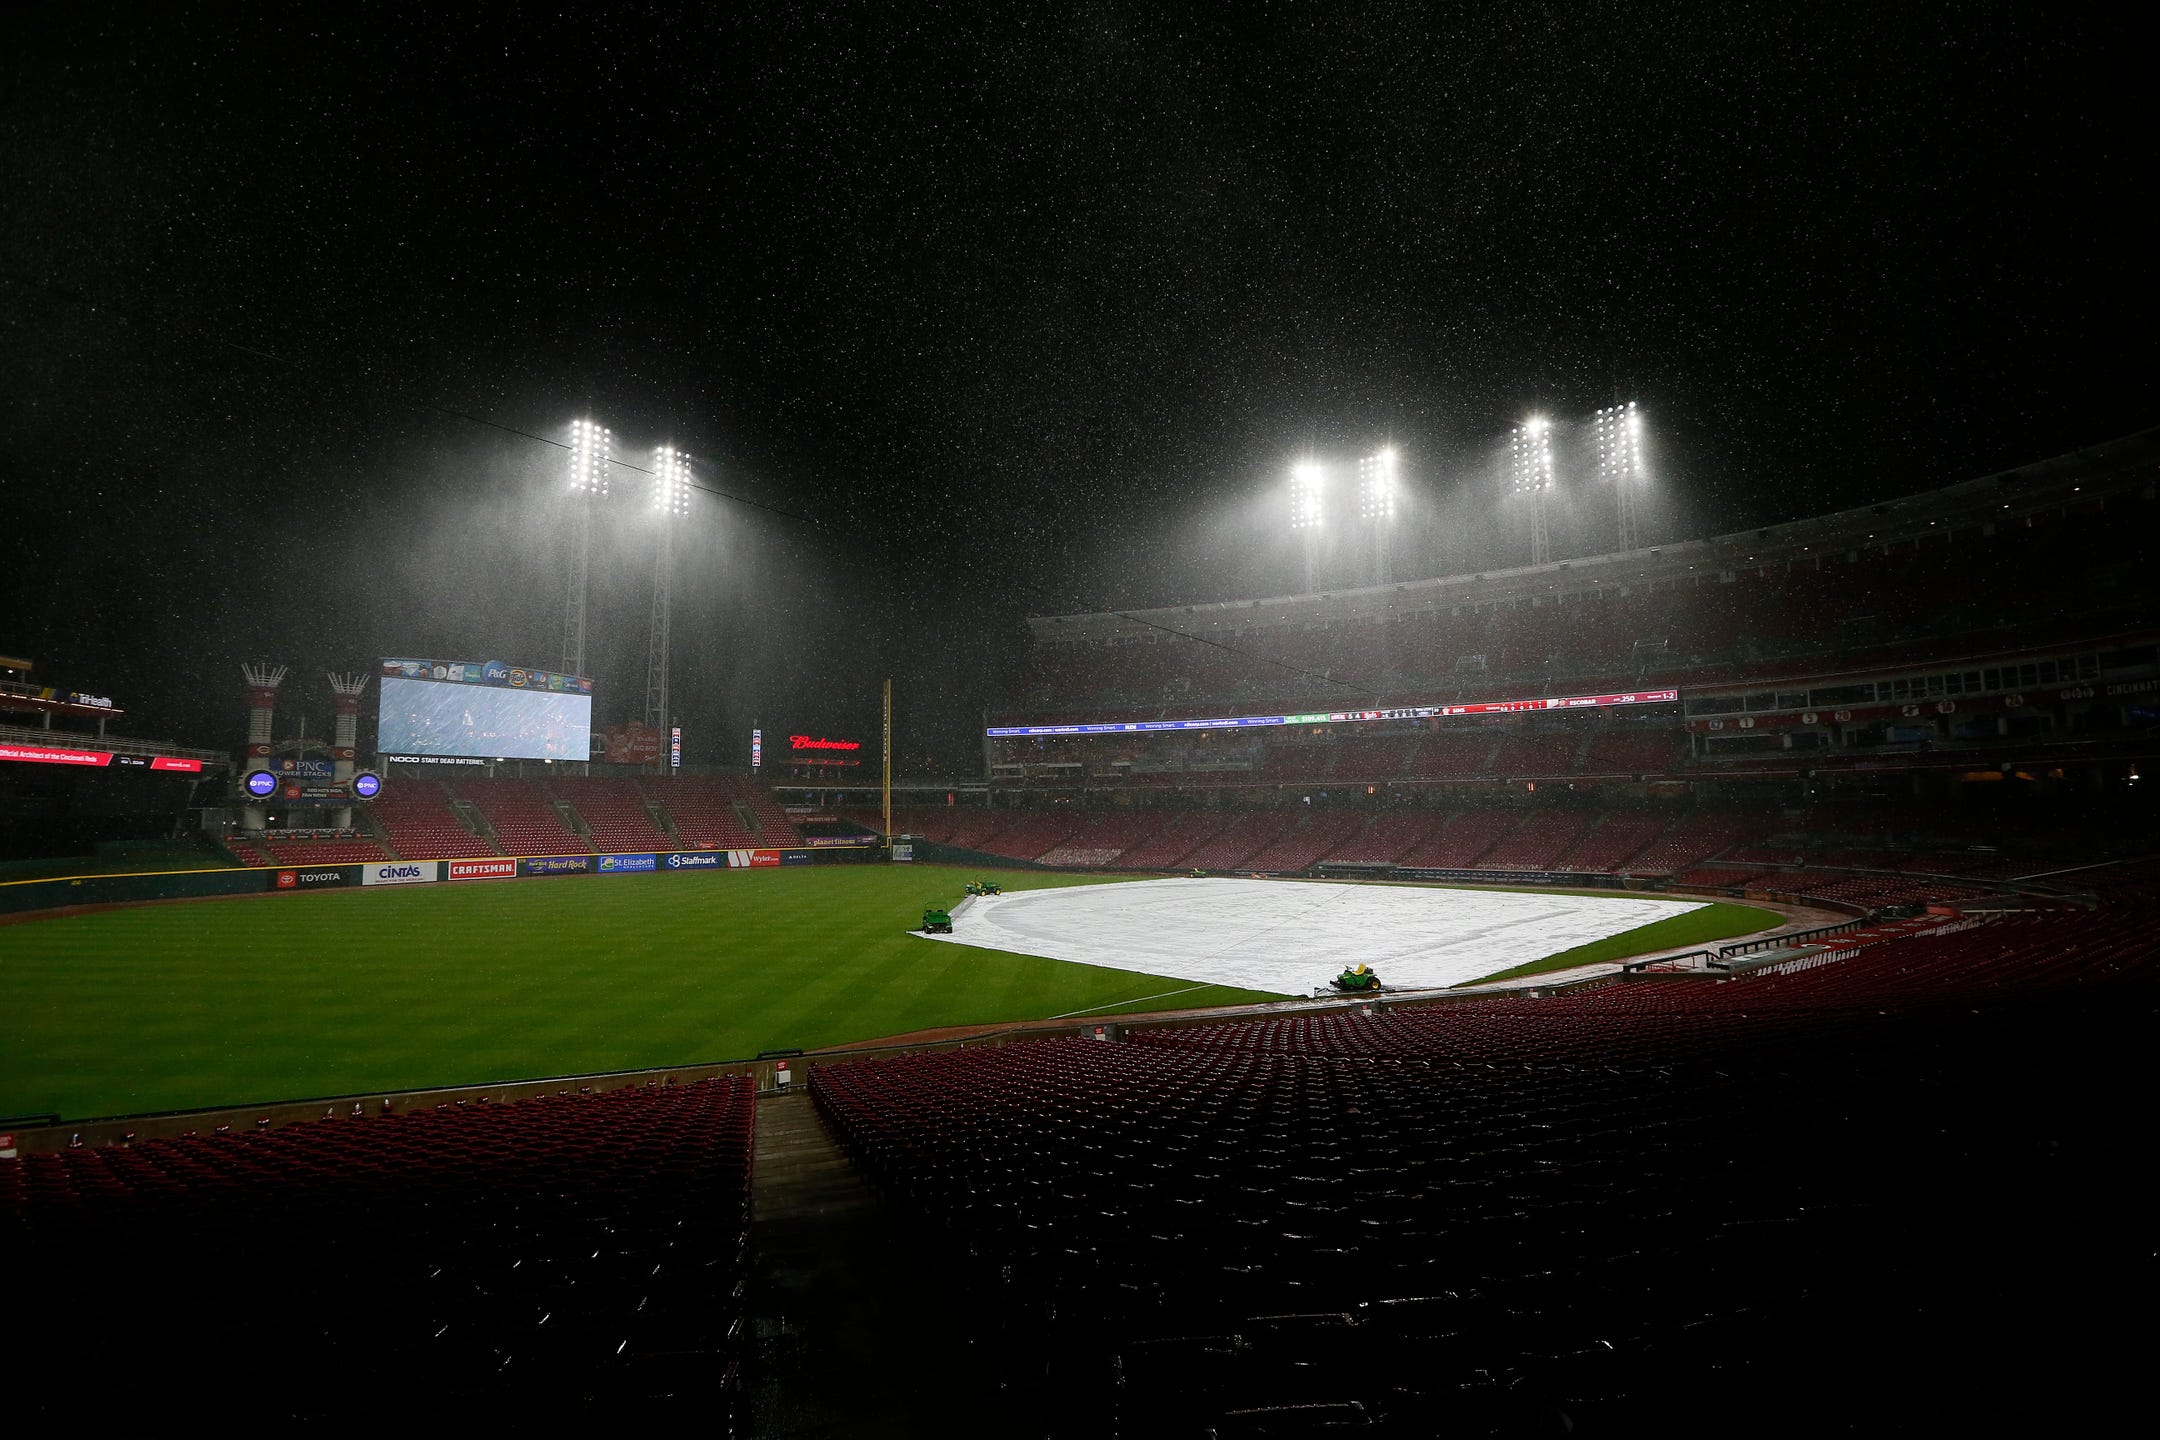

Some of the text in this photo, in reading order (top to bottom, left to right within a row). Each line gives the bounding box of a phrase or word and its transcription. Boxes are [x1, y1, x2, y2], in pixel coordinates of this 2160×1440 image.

[488, 668, 506, 679] P&G
[511, 673, 525, 683] Tide
[78, 693, 112, 708] TriHealth
[1569, 698, 1596, 706] ESCOBAR
[790, 736, 860, 750] Budweiser
[20, 751, 44, 759] Architect
[61, 754, 84, 762] Cincinnati
[296, 761, 325, 771] PNC
[548, 859, 587, 869] Hard Rock
[623, 858, 655, 866] Elizabeth
[681, 856, 717, 865] Staffmark
[453, 863, 513, 875] CRAFTSMAN
[300, 872, 341, 882] TOYOTA
